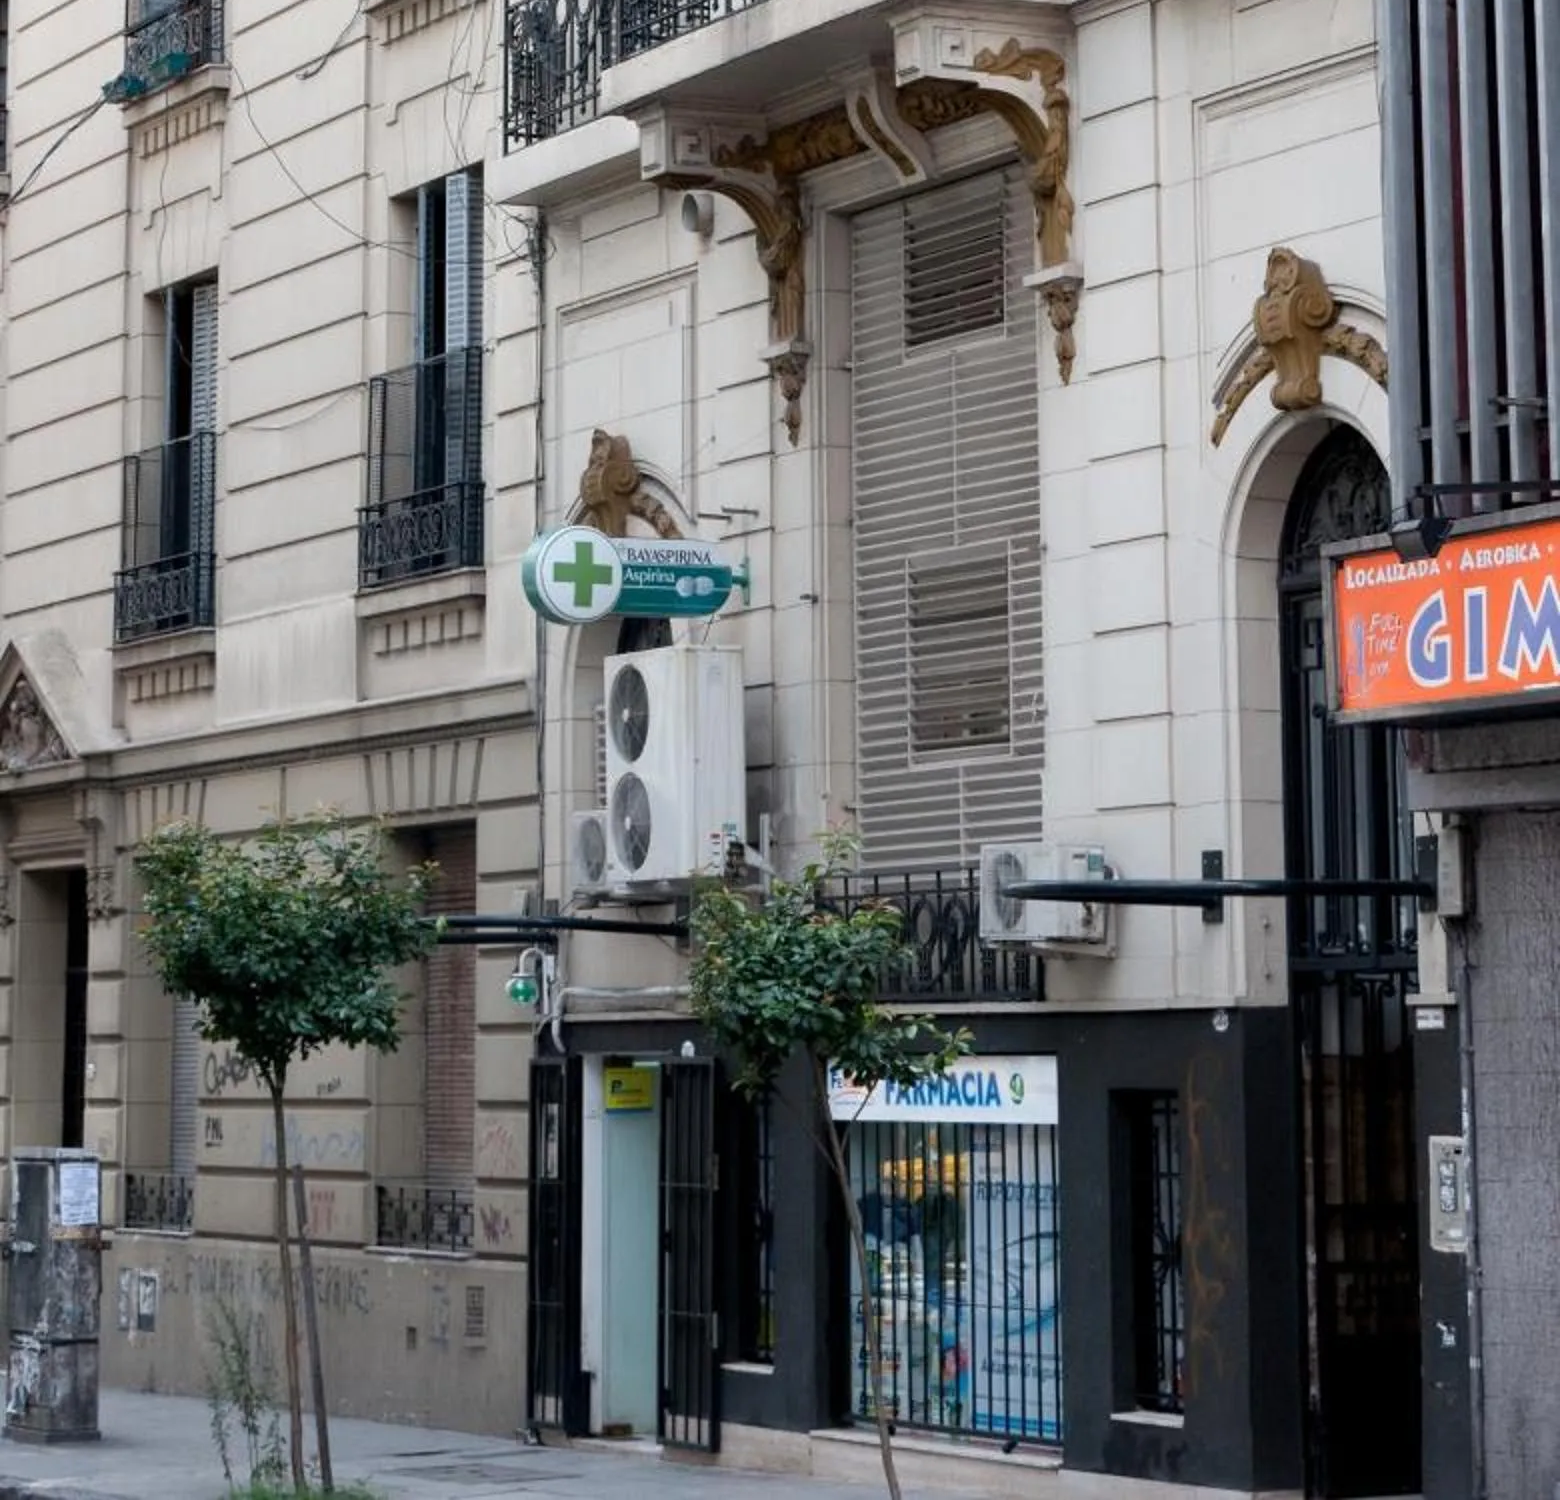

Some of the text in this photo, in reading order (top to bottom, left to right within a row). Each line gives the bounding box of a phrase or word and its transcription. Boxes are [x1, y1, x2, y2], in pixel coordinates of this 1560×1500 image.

[627, 547, 712, 565] BAYASPIRINA
[1345, 541, 1541, 589] LOCALIZADA AEROBICA
[623, 566, 675, 588] Aspirina
[885, 1071, 1001, 1107] FARMACIA
